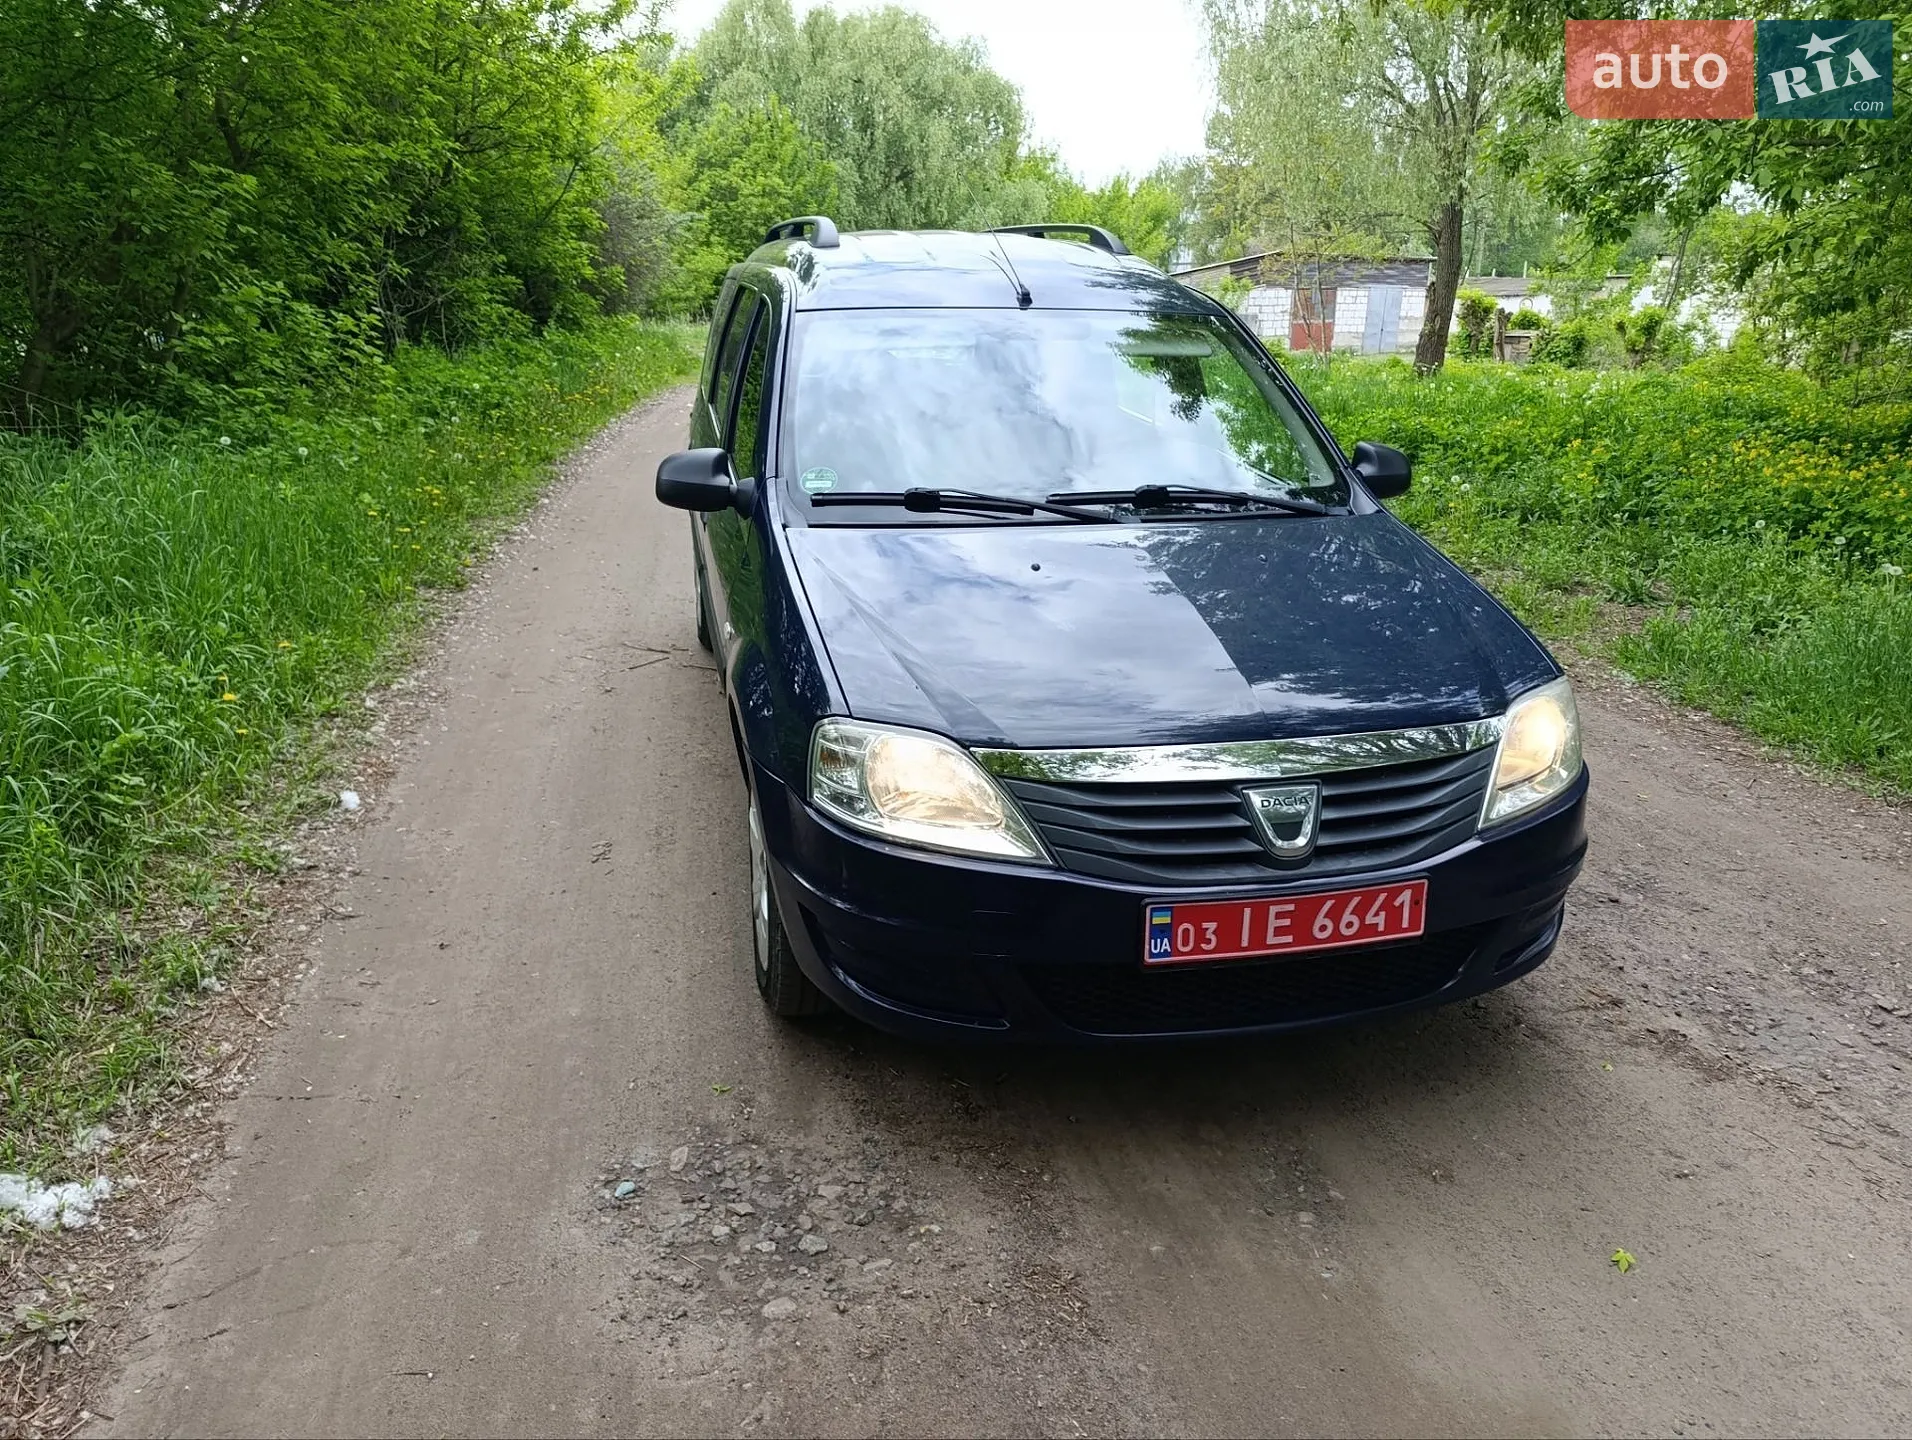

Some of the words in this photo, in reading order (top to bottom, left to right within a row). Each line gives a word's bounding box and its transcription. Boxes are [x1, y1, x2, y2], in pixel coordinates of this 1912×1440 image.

[1261, 796, 1310, 808] DACIA
[1177, 922, 1218, 952] 03
[1313, 889, 1412, 940] 6641
[1151, 938, 1171, 953] UA
